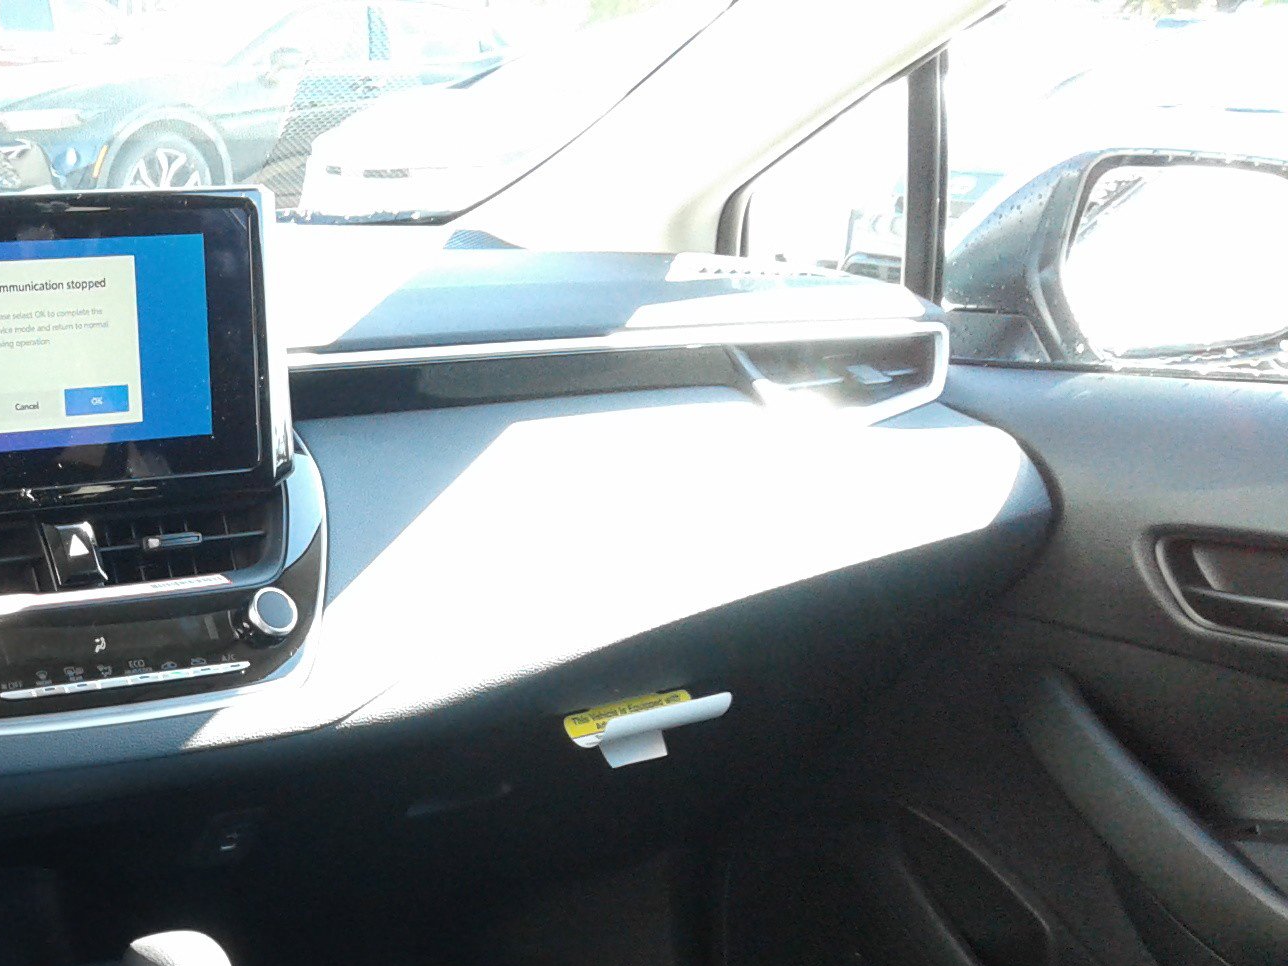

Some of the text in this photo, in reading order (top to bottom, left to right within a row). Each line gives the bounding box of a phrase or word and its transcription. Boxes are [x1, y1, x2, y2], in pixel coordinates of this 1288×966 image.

[66, 278, 107, 291] stopped
[12, 311, 33, 320] select
[47, 309, 55, 317] to
[56, 307, 90, 318] complete
[14, 324, 35, 333] mode
[36, 324, 51, 332] and
[52, 323, 73, 331] return
[74, 322, 83, 330] to
[83, 320, 109, 329] normal
[14, 401, 40, 411] Cancel
[128, 659, 145, 669] ECO
